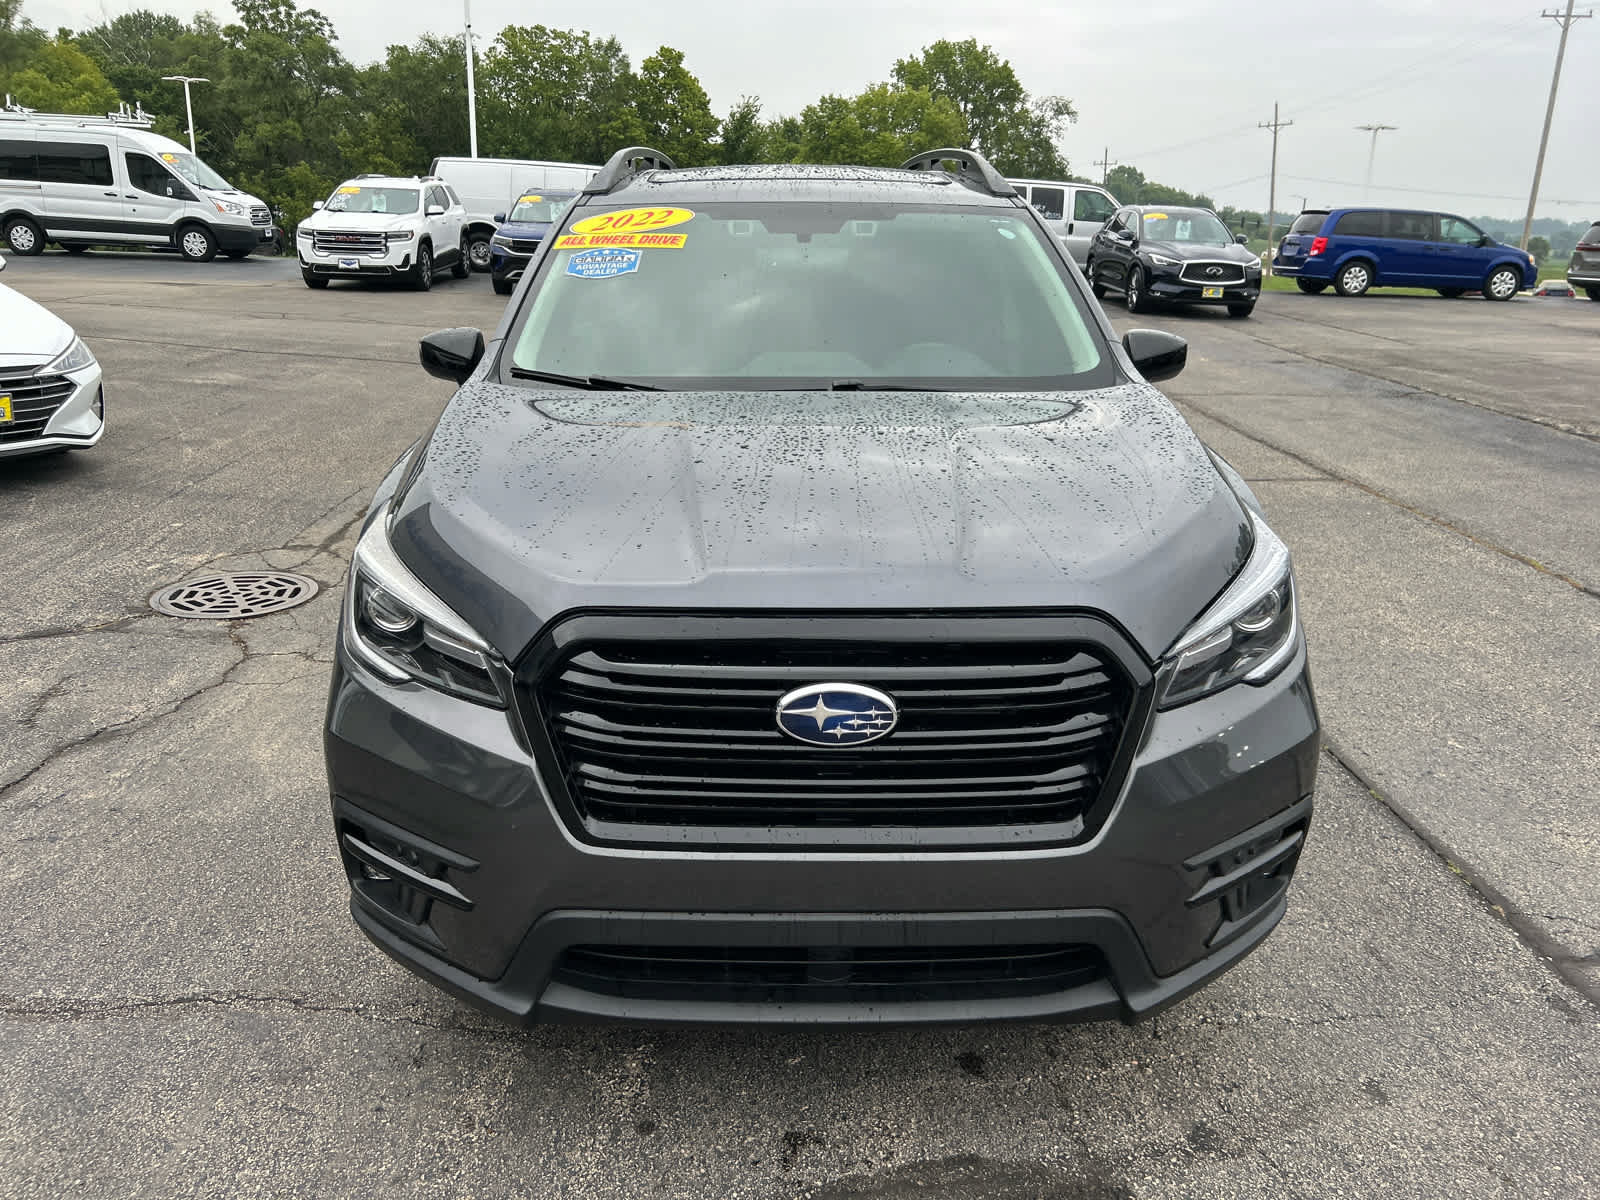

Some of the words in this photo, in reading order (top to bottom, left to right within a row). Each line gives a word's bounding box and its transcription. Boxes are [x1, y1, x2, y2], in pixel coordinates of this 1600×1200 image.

[591, 210, 673, 231] 2022
[561, 236, 586, 246] ALL
[589, 235, 635, 245] WHEEL
[639, 235, 681, 245] DRIVE
[574, 255, 635, 264] CARFAX
